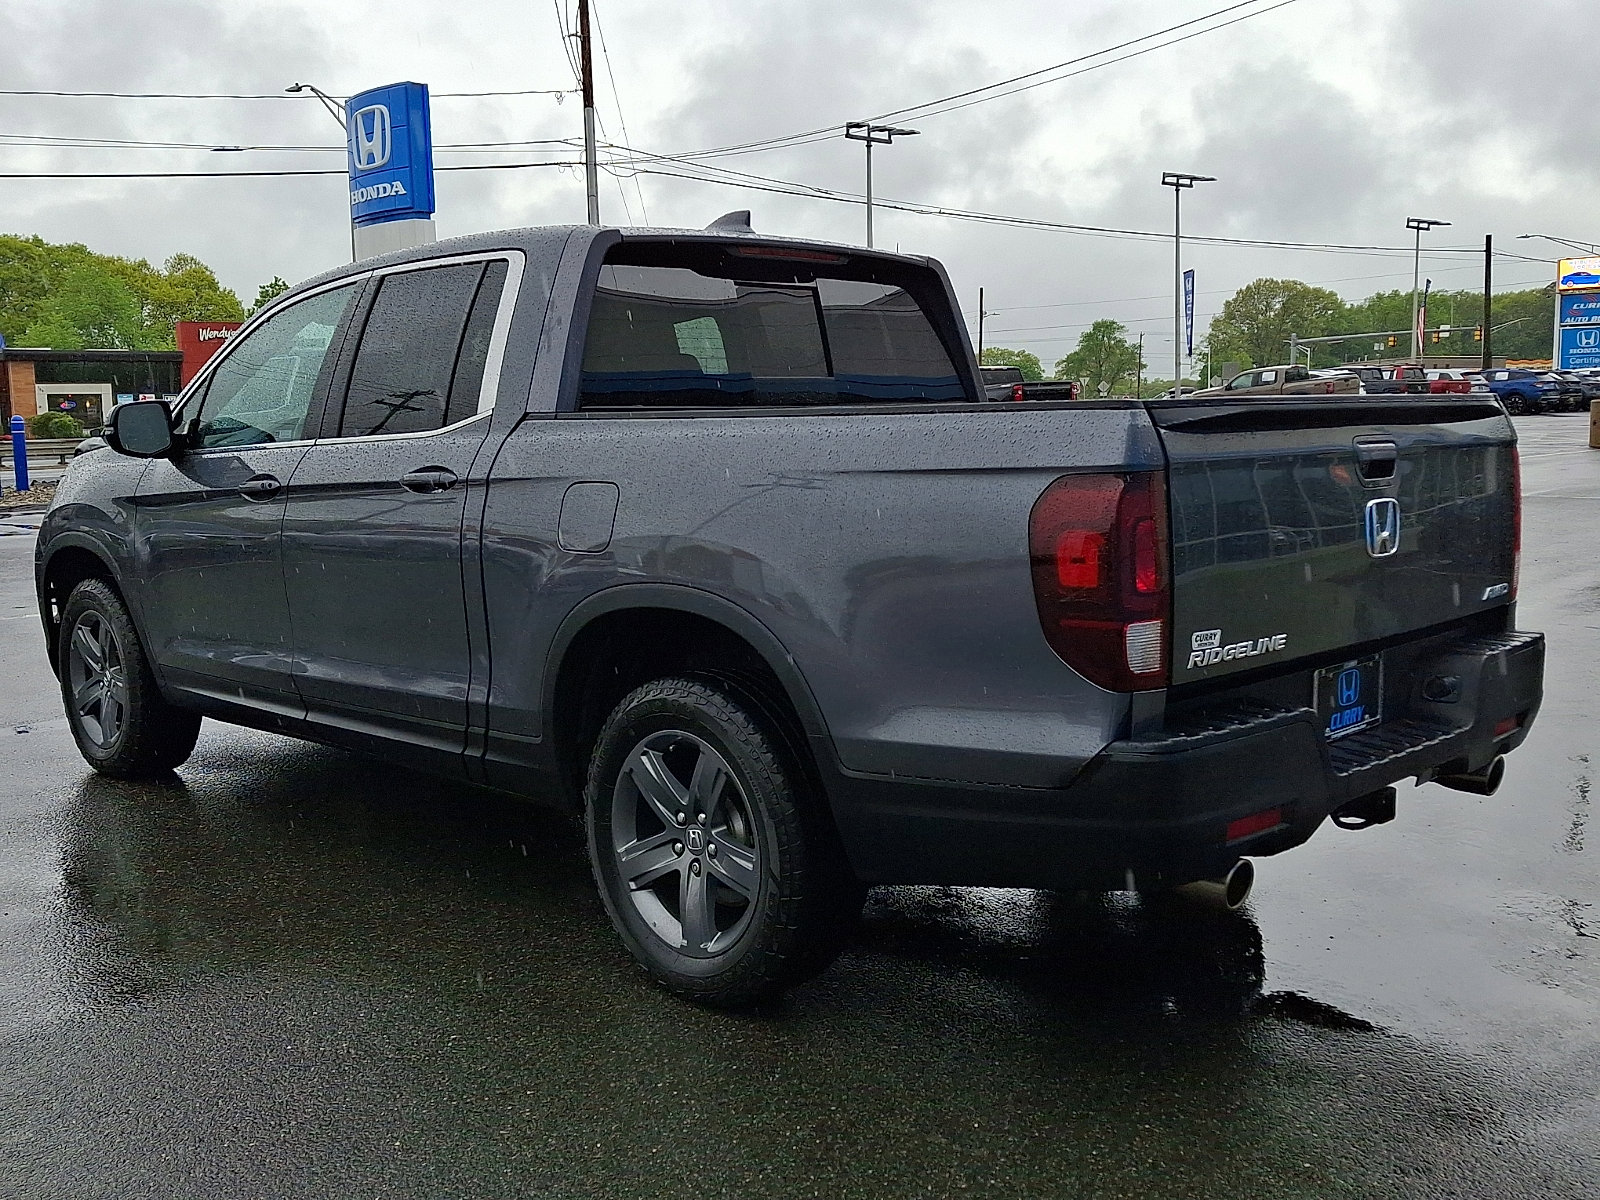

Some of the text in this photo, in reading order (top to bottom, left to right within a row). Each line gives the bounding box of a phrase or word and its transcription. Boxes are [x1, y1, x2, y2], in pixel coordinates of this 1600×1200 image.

[350, 181, 407, 205] HONDA
[1195, 632, 1218, 642] CURRY
[1187, 634, 1287, 669] RIDGELINE
[1330, 706, 1364, 730] CURRY
